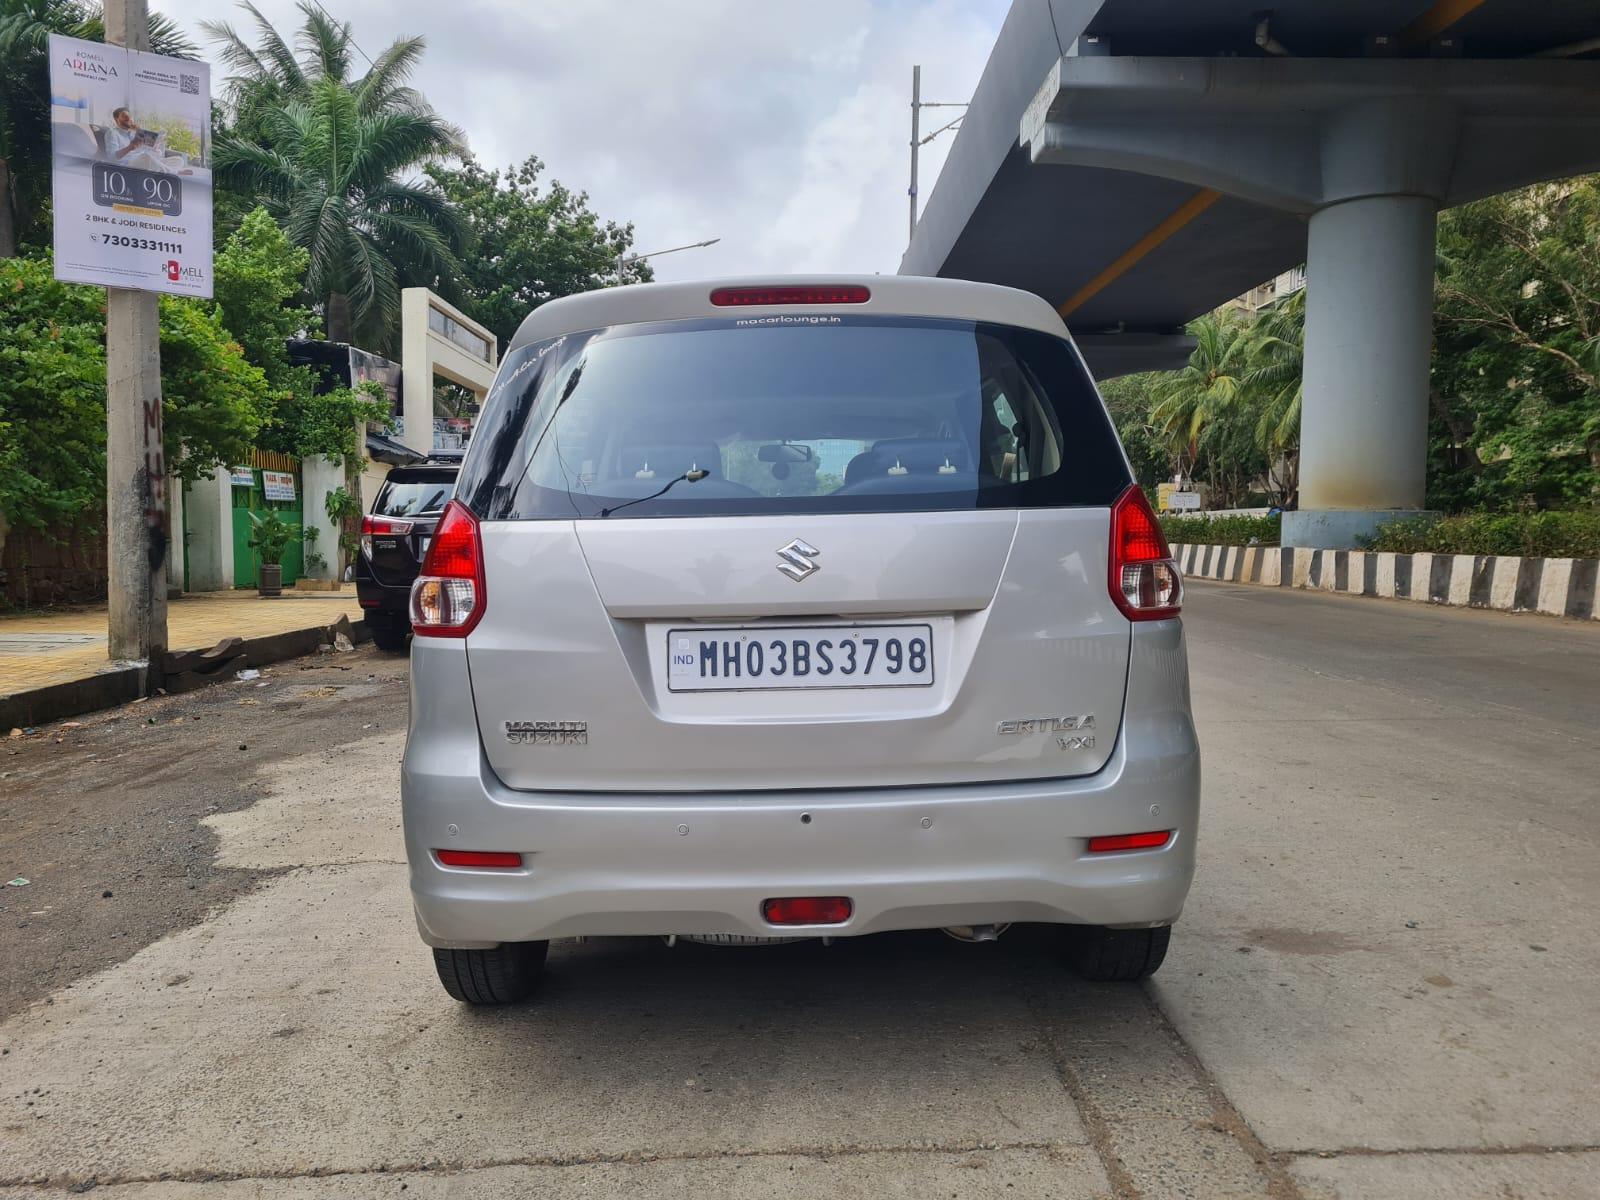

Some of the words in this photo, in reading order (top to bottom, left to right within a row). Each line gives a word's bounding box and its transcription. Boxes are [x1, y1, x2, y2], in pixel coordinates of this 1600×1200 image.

[63, 57, 118, 77] ARIANA
[92, 215, 110, 225] BHK
[111, 217, 117, 225] &
[118, 218, 138, 228] JODI
[139, 221, 187, 235] RESIDENCES
[102, 234, 182, 254] 7303331111
[736, 316, 841, 327] macarlounge.in
[673, 655, 694, 665] IND
[699, 638, 927, 677] MH03BS3798
[505, 720, 587, 732] MARUTI
[997, 714, 1096, 735] ERTIGA
[506, 732, 588, 745] SUZUKI
